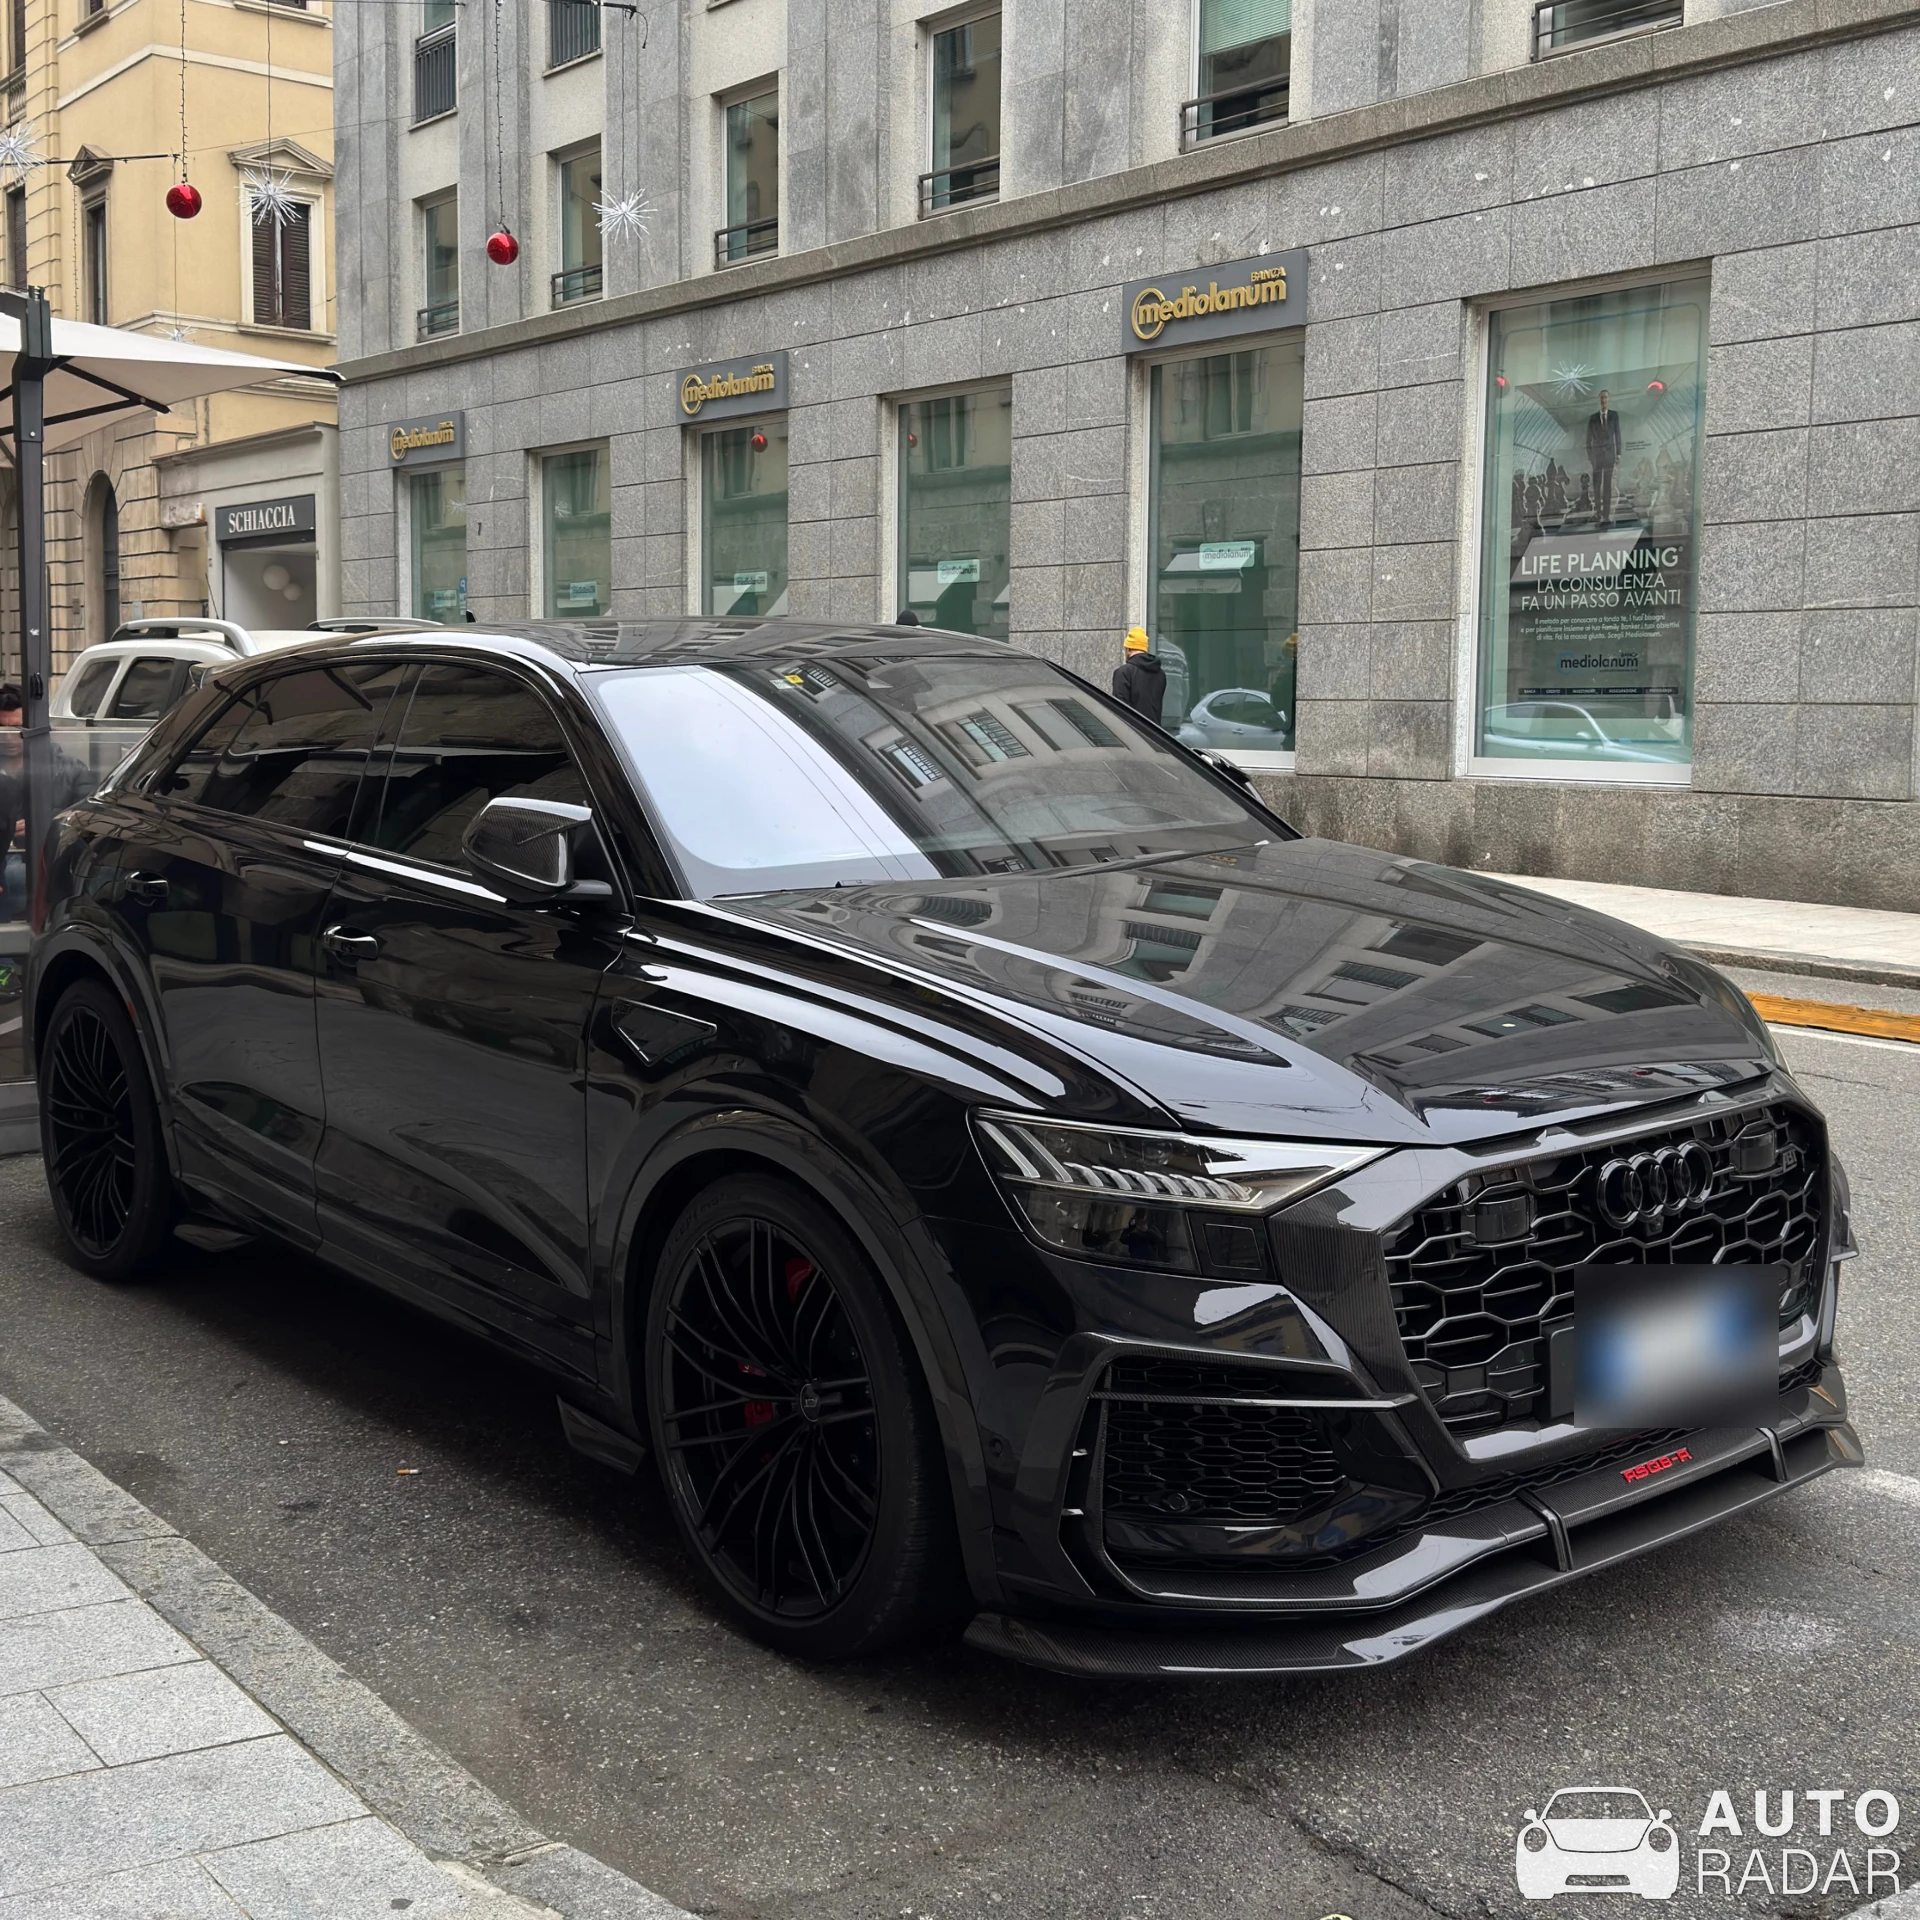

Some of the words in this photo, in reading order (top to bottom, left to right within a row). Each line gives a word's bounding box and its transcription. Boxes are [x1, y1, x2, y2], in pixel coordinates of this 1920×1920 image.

[1251, 266, 1287, 282] BANCA
[1138, 279, 1287, 325] mediolanum
[685, 371, 775, 402] mediolanum
[228, 505, 296, 533] SCHIACCIA
[1521, 554, 1562, 576] LIFE
[1537, 578, 1555, 594] LA
[1559, 573, 1667, 594] CONSULENZA
[1521, 596, 1540, 611] FA
[1544, 594, 1567, 610] UN
[1570, 592, 1620, 609] PASSO
[1623, 589, 1682, 608] AVANTI
[1560, 654, 1639, 669] mediolanum
